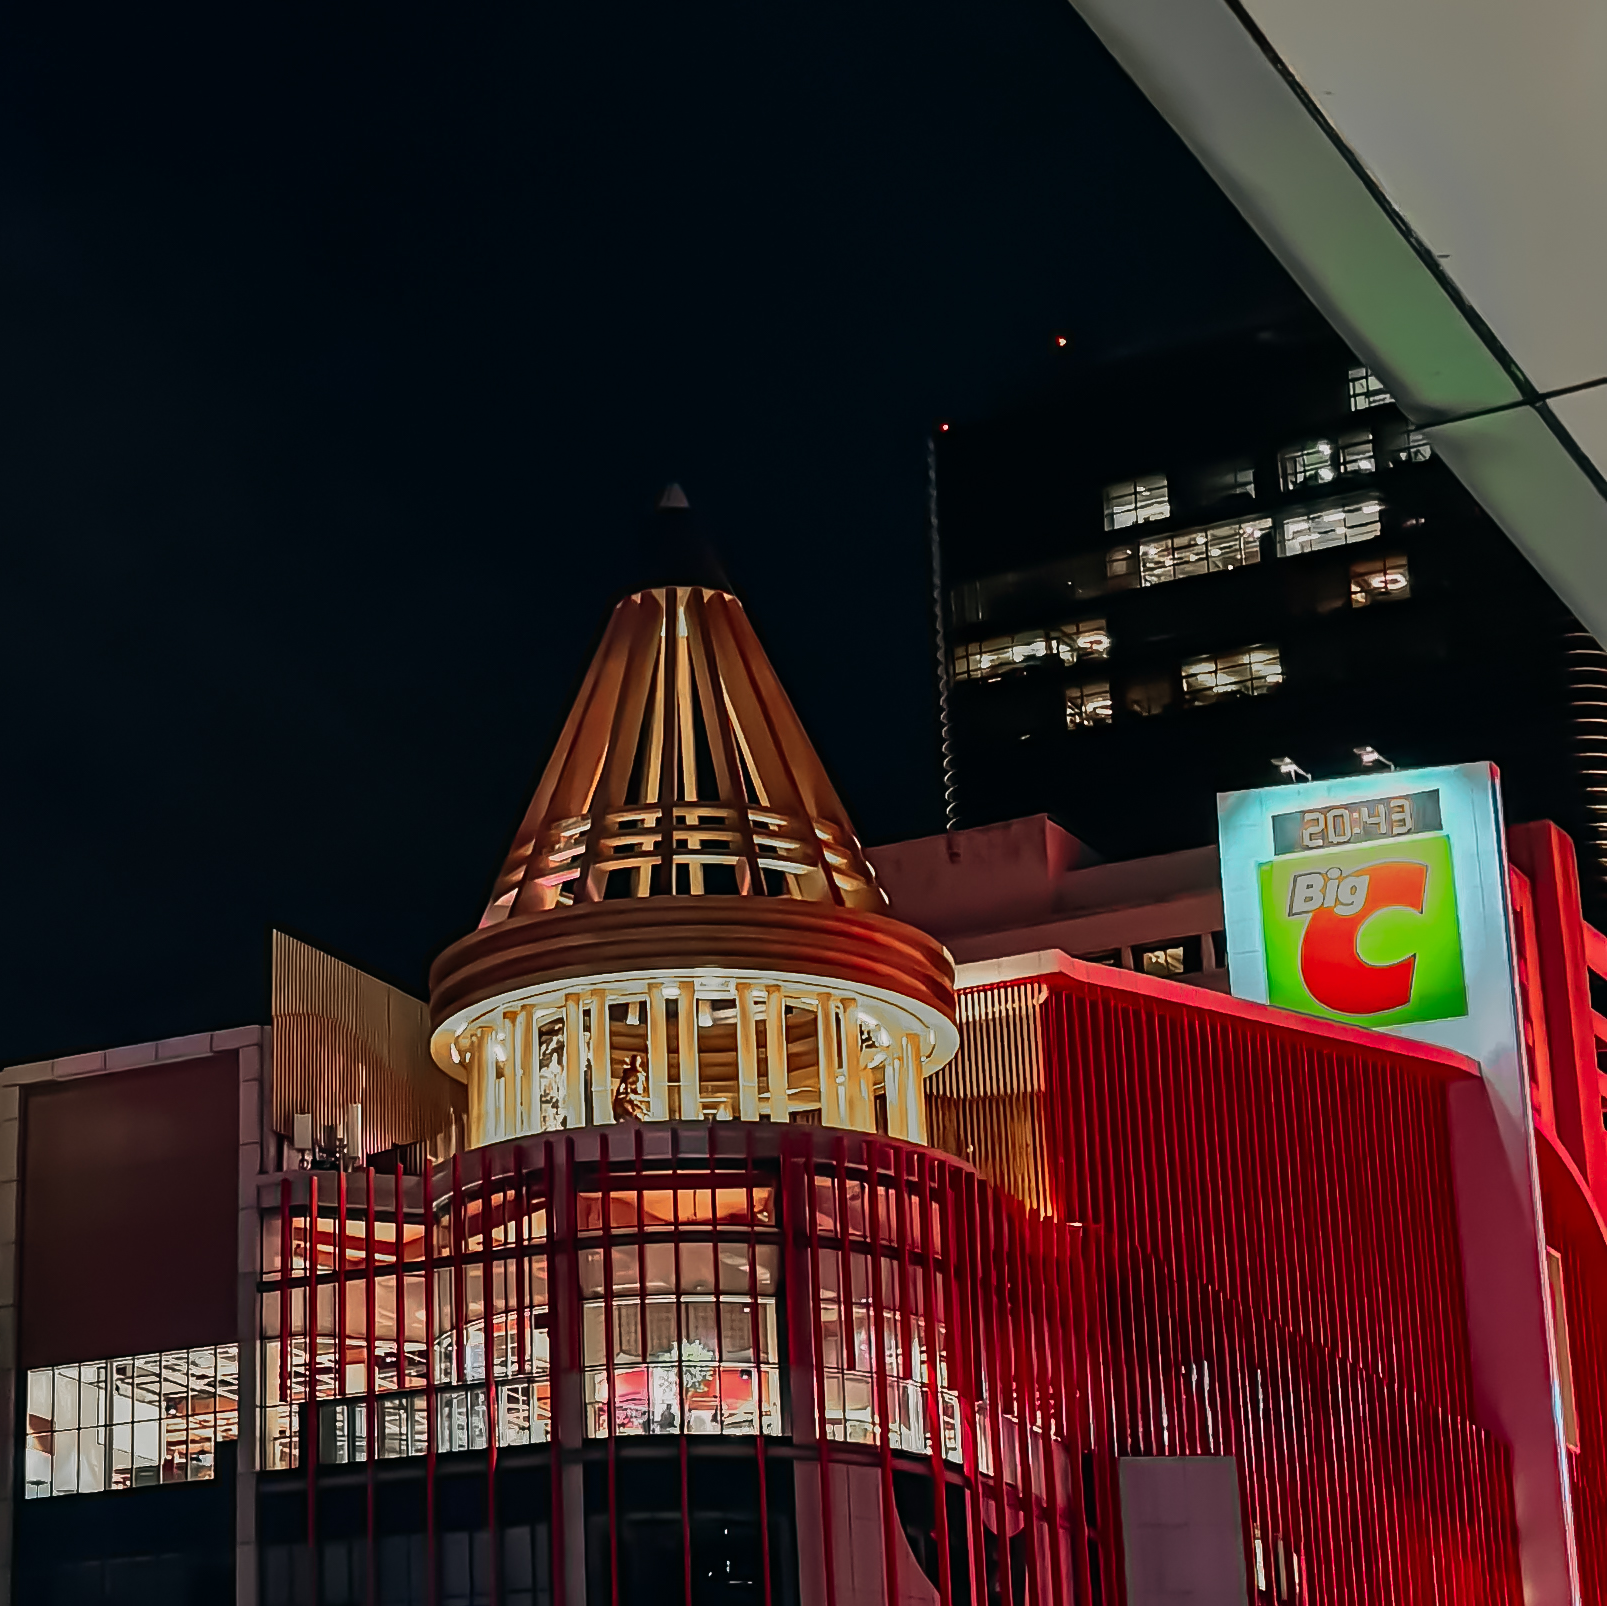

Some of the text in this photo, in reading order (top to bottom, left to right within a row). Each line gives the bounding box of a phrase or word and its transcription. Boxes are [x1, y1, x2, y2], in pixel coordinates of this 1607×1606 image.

[1302, 799, 1413, 848] 20:43
[1288, 859, 1429, 1017] Big C
